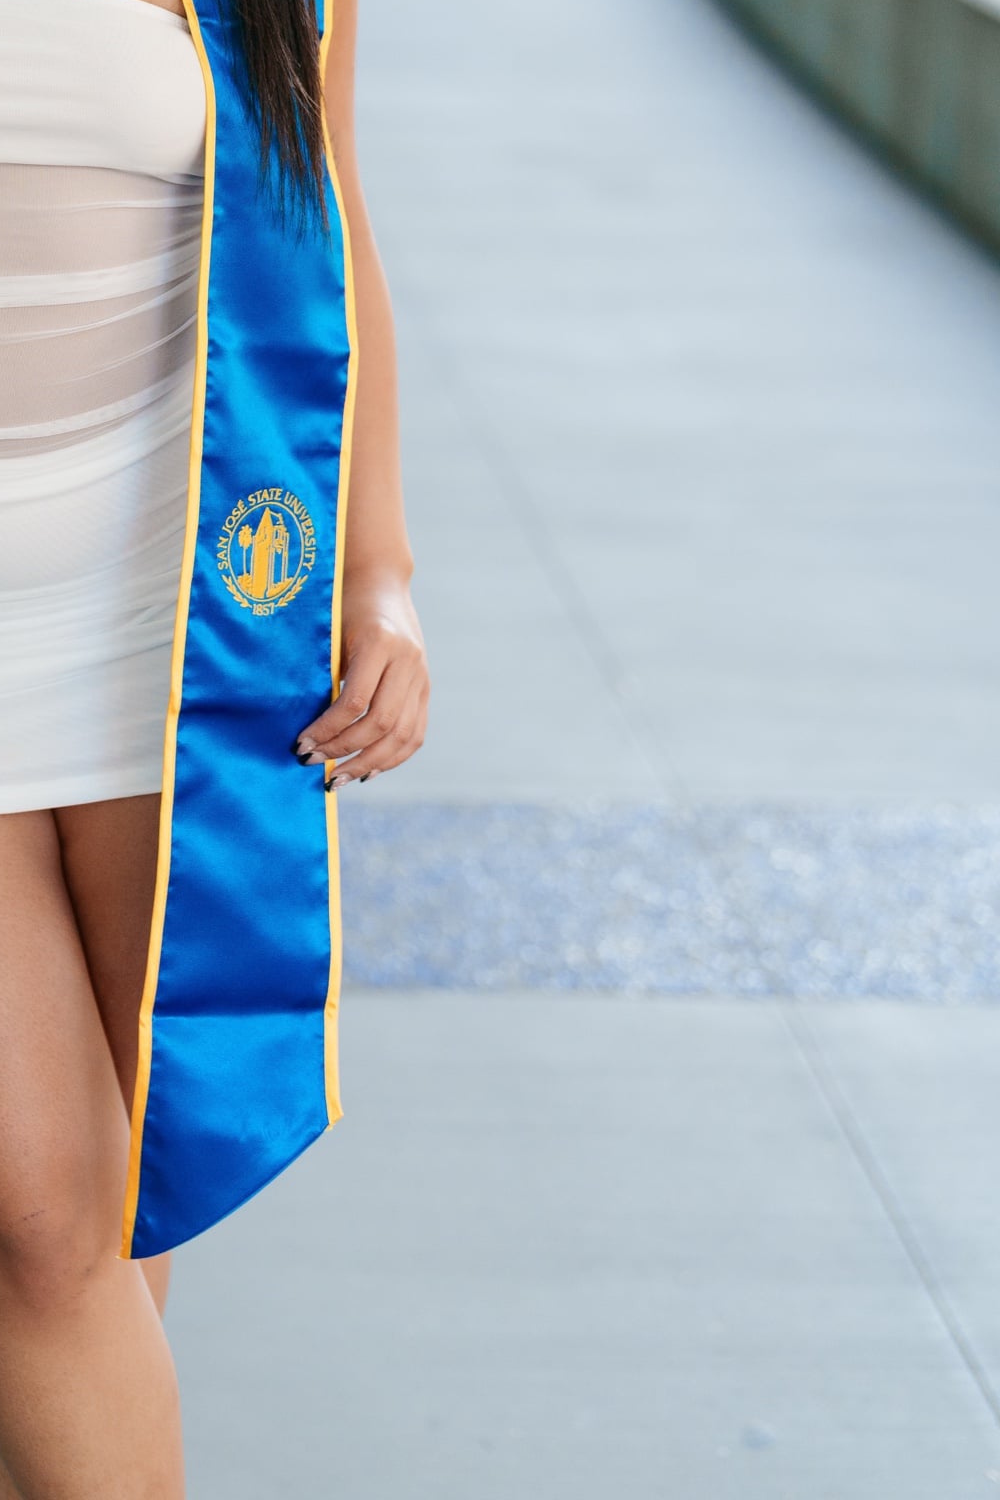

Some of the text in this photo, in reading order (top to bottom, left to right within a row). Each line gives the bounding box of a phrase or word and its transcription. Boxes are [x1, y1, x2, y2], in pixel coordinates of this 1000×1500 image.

[217, 537, 229, 570] SAN
[248, 487, 283, 506] STATE
[284, 491, 316, 571] UNIVERSITY
[252, 602, 275, 616] 1857
